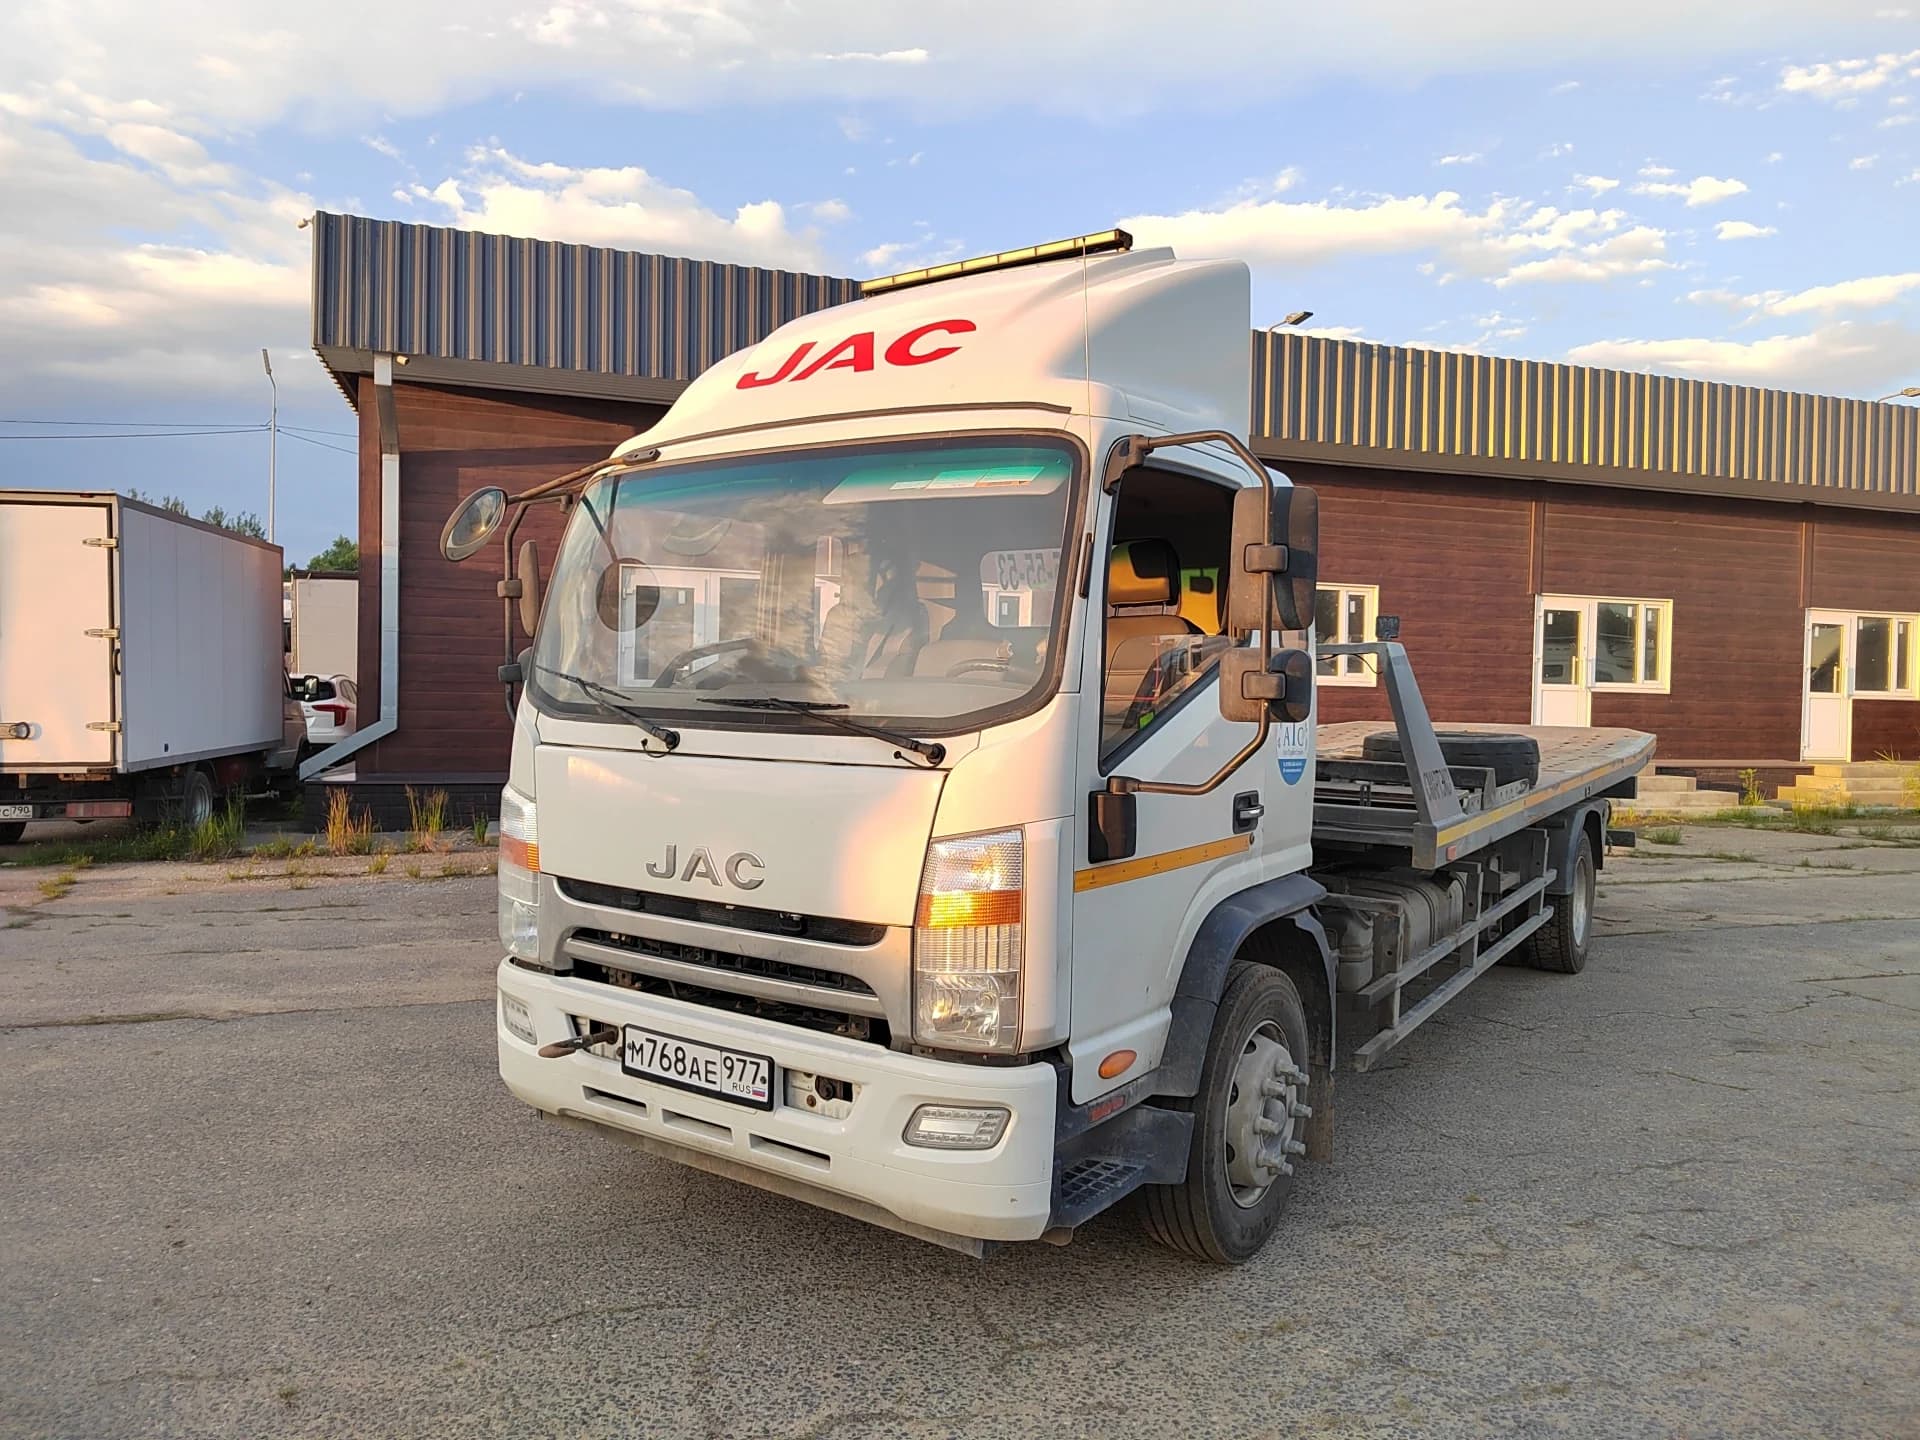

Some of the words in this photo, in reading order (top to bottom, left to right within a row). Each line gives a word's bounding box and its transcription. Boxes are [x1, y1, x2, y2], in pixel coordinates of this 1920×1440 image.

[736, 319, 977, 390] JAC
[646, 844, 766, 891] JAC
[631, 1037, 717, 1085] M768AE
[723, 1055, 761, 1085] 977
[732, 1082, 752, 1095] RUS
